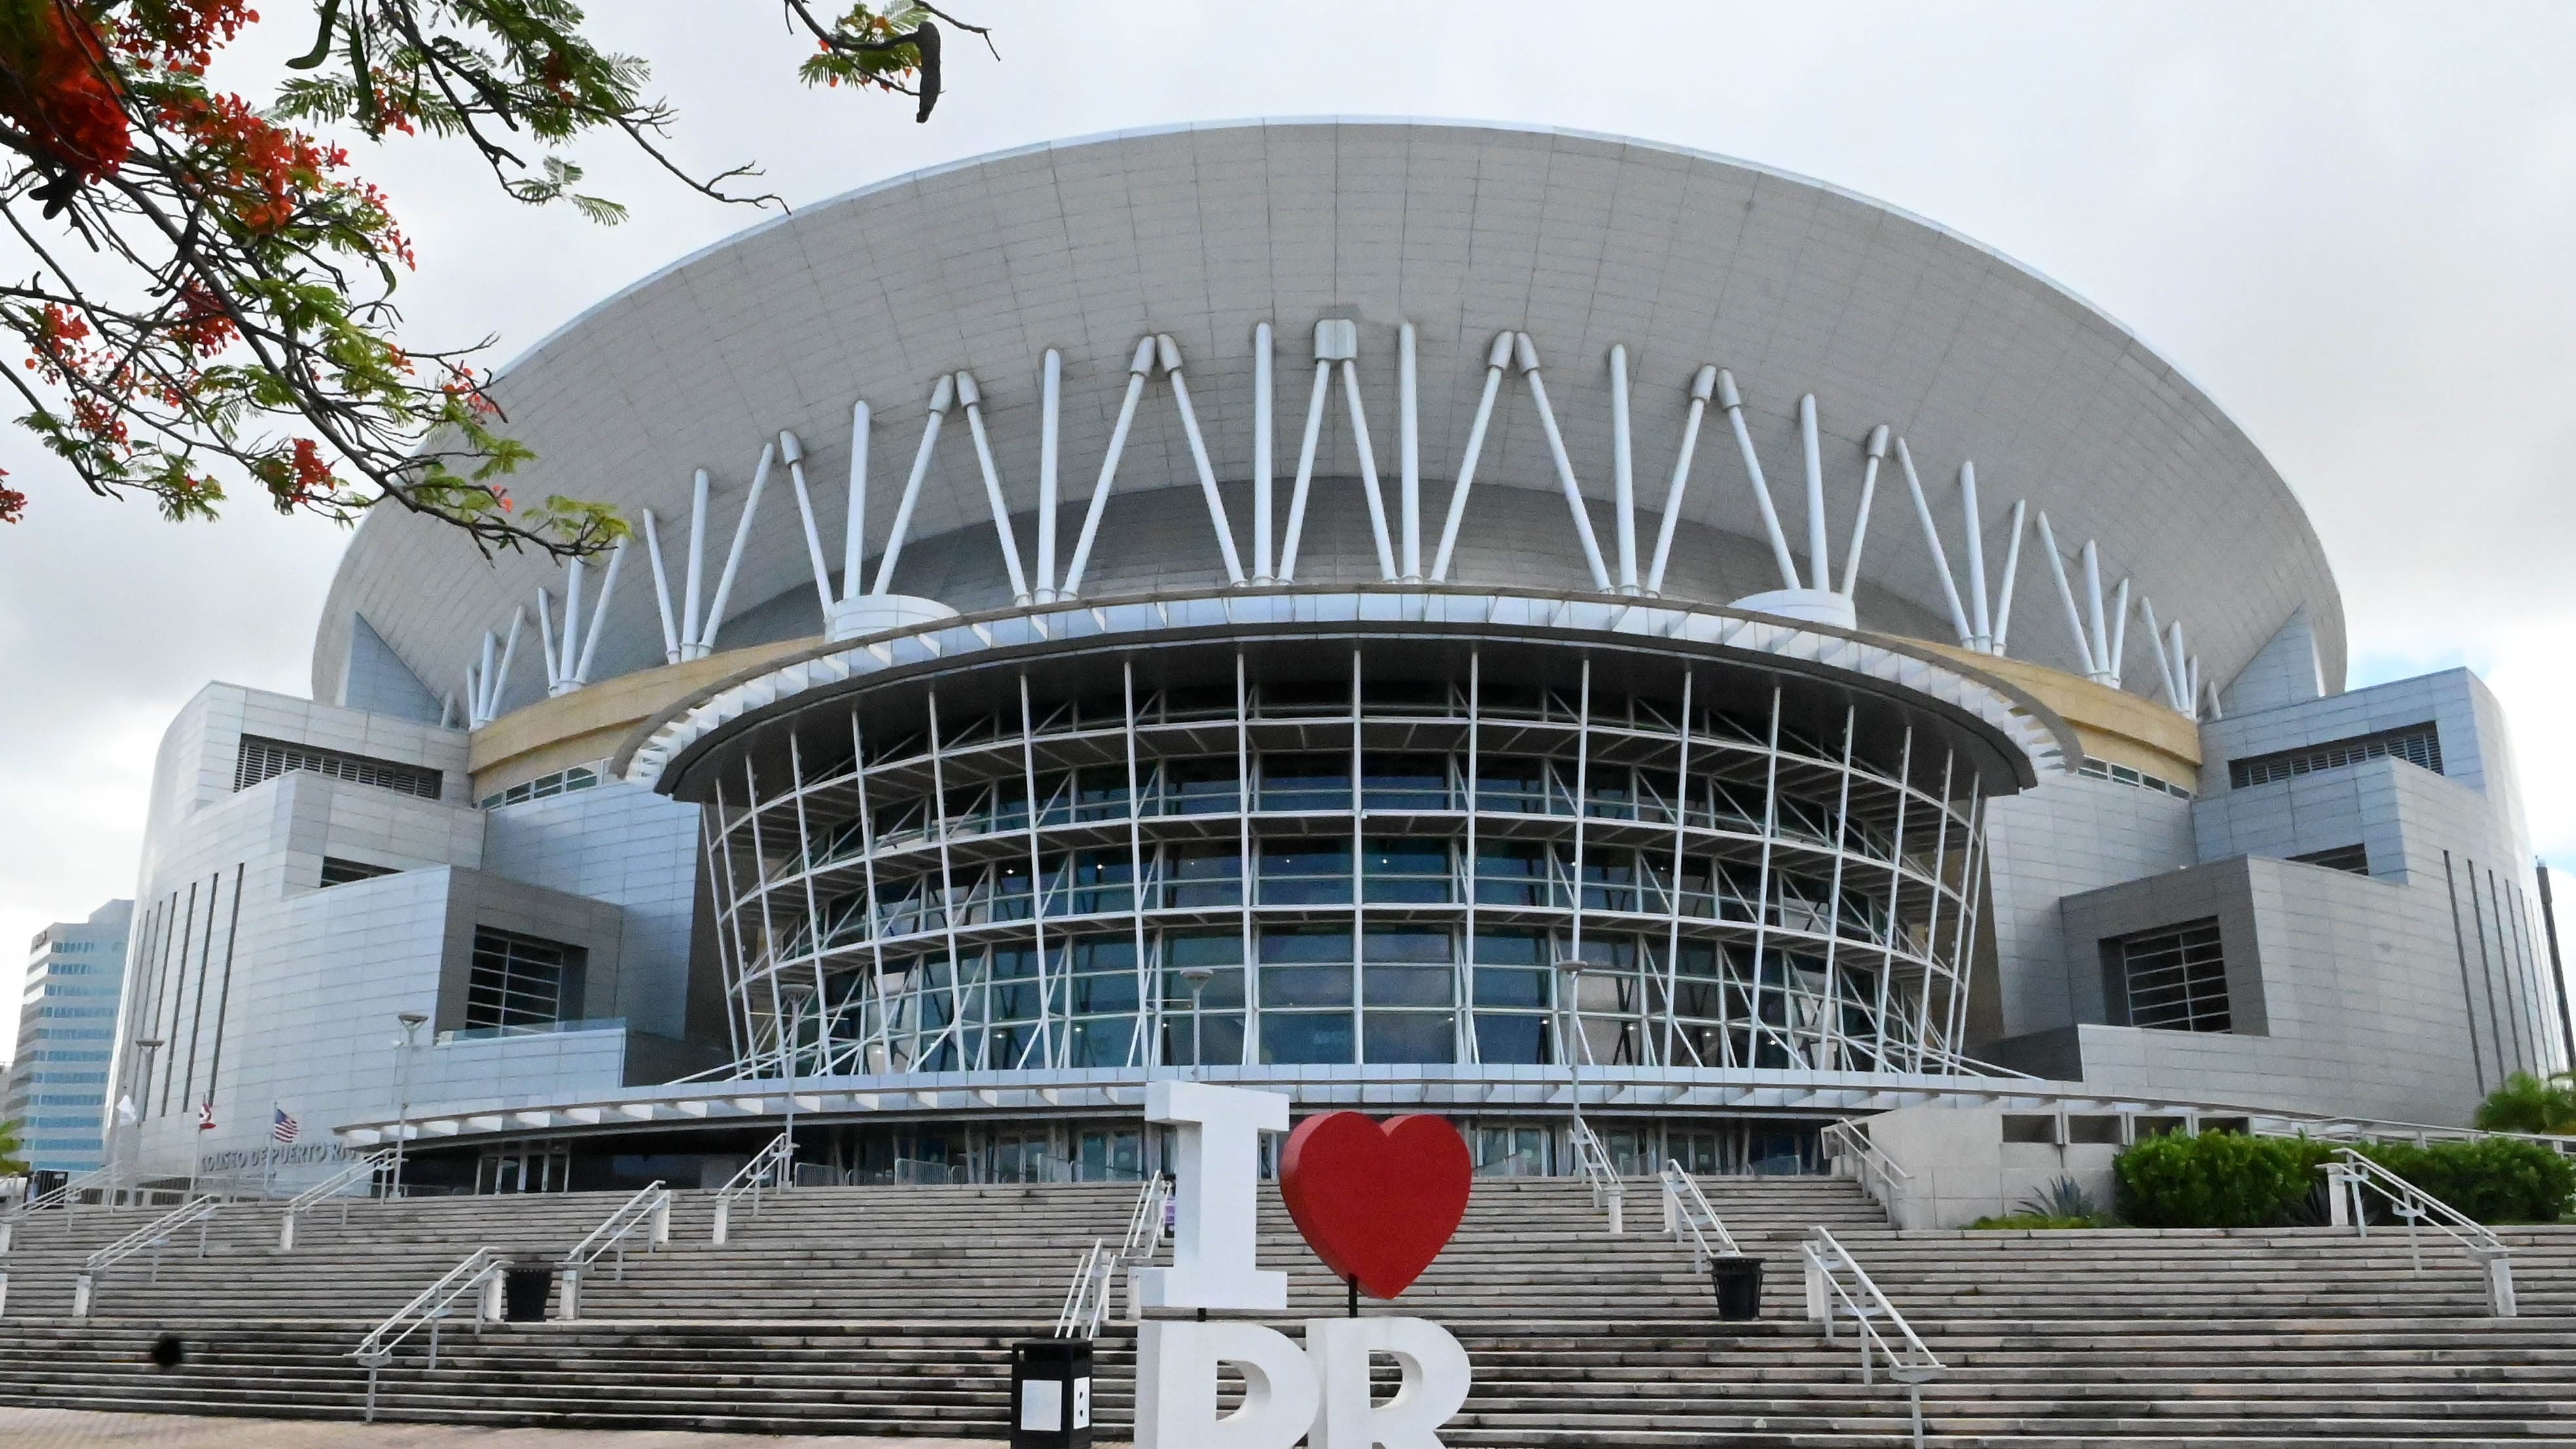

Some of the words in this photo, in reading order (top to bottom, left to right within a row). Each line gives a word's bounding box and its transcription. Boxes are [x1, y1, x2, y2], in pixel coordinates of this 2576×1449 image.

[201, 1150, 249, 1172] COLISEO
[250, 1146, 269, 1168] DE
[270, 1143, 327, 1164] PUERTO
[1128, 1080, 1289, 1310] I
[1134, 1316, 1471, 1449] PR
